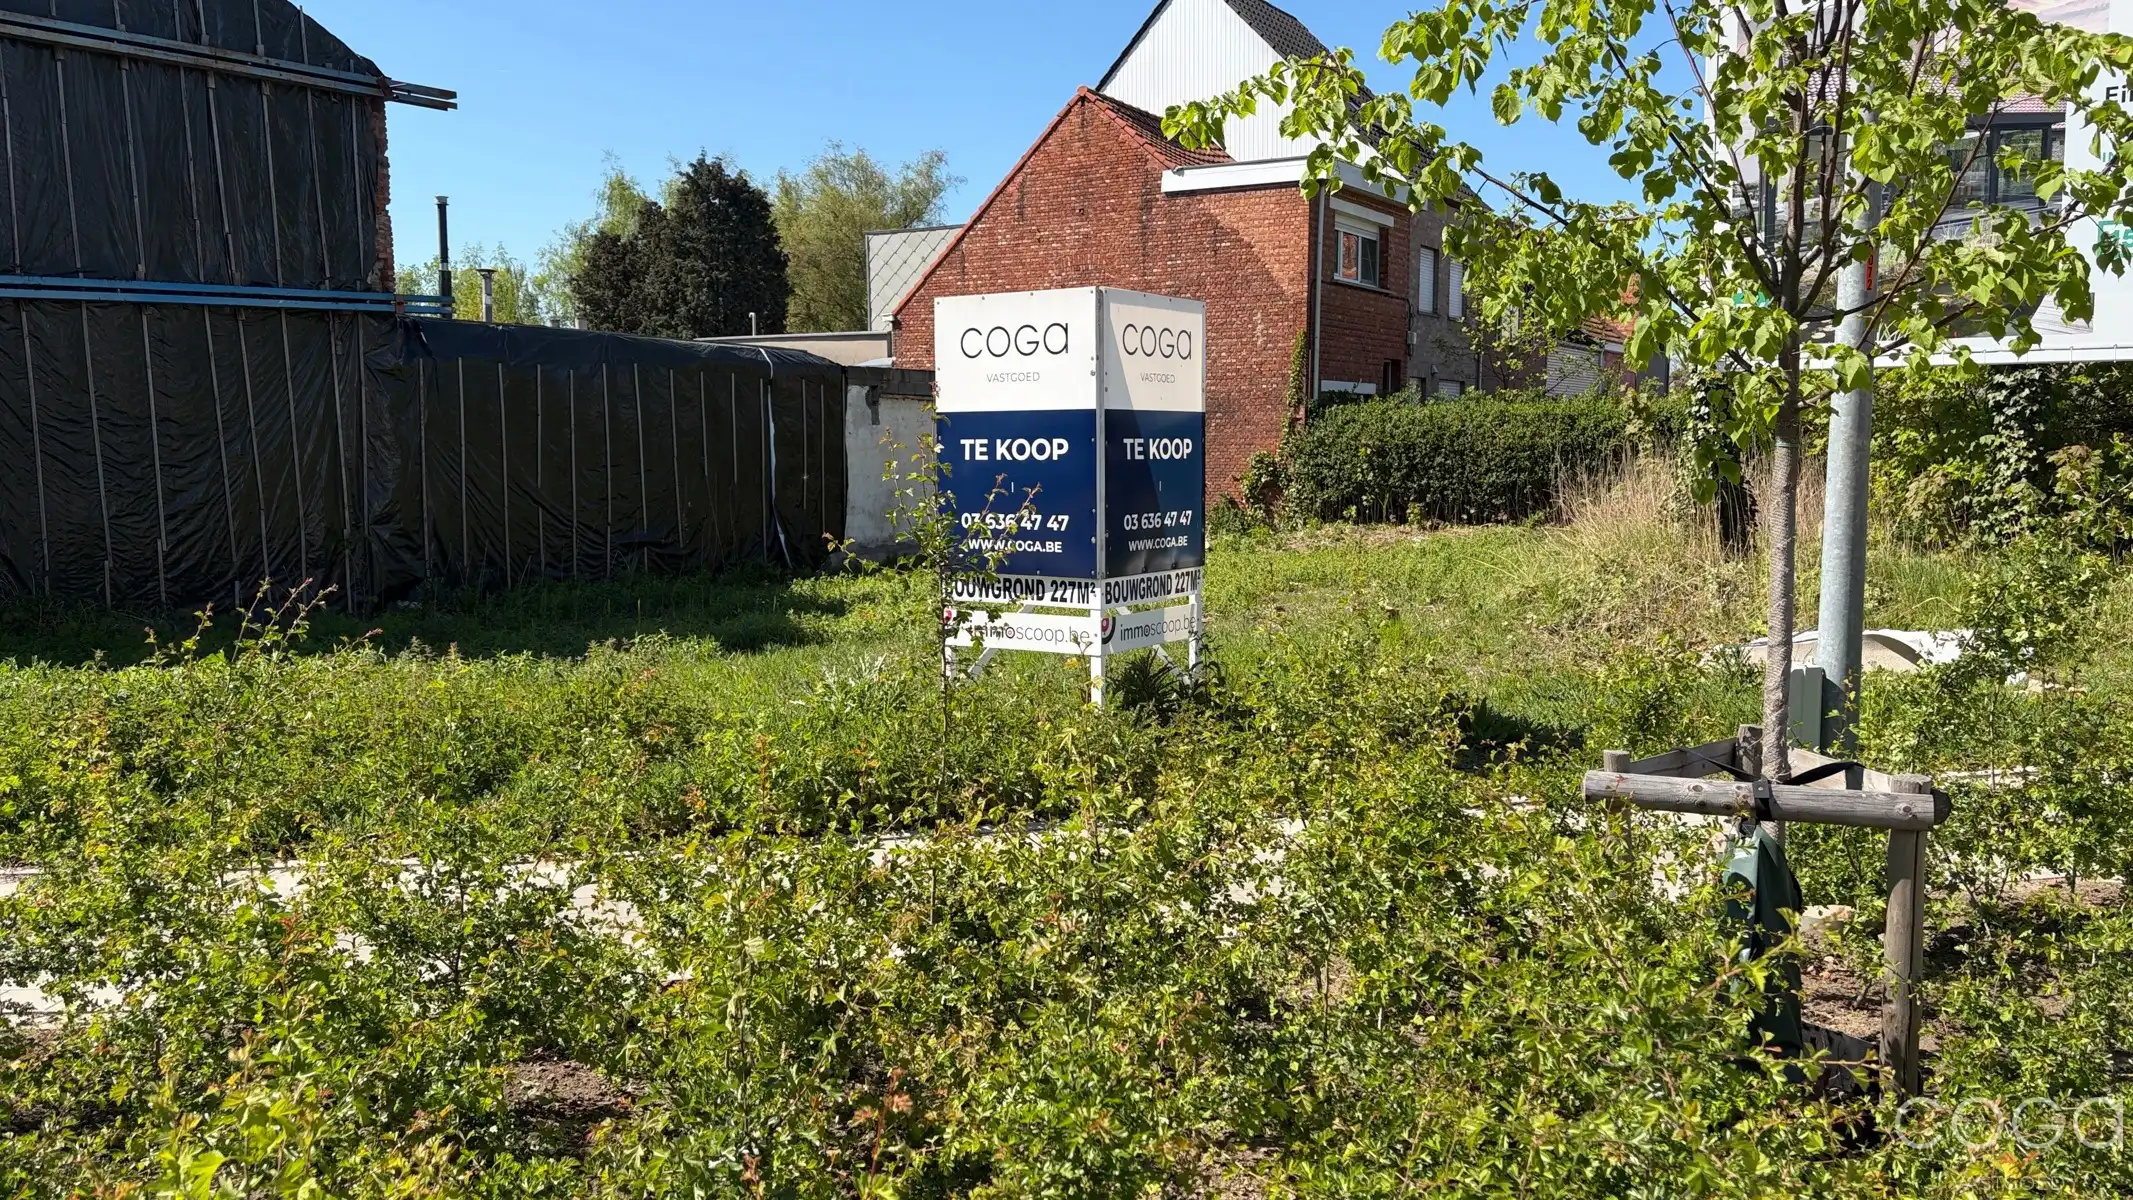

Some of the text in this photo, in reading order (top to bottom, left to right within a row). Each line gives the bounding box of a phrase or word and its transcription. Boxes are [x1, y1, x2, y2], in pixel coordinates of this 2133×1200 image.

[986, 371, 1040, 383] VASTGOED
[1140, 372, 1176, 384] VASTGOED
[960, 438, 1069, 461] TE KOOP
[1123, 437, 1193, 460] TE KOOP
[1020, 514, 1042, 531] 47
[1046, 514, 1070, 532] 47
[1123, 510, 1192, 531] 03 636 47 47
[968, 538, 1063, 553] WWW.COGA.BE
[1128, 535, 1188, 552] WWW.COGA.BE
[1104, 573, 1173, 605] BOUWGROND
[1120, 613, 1196, 642] immoscoop.be
